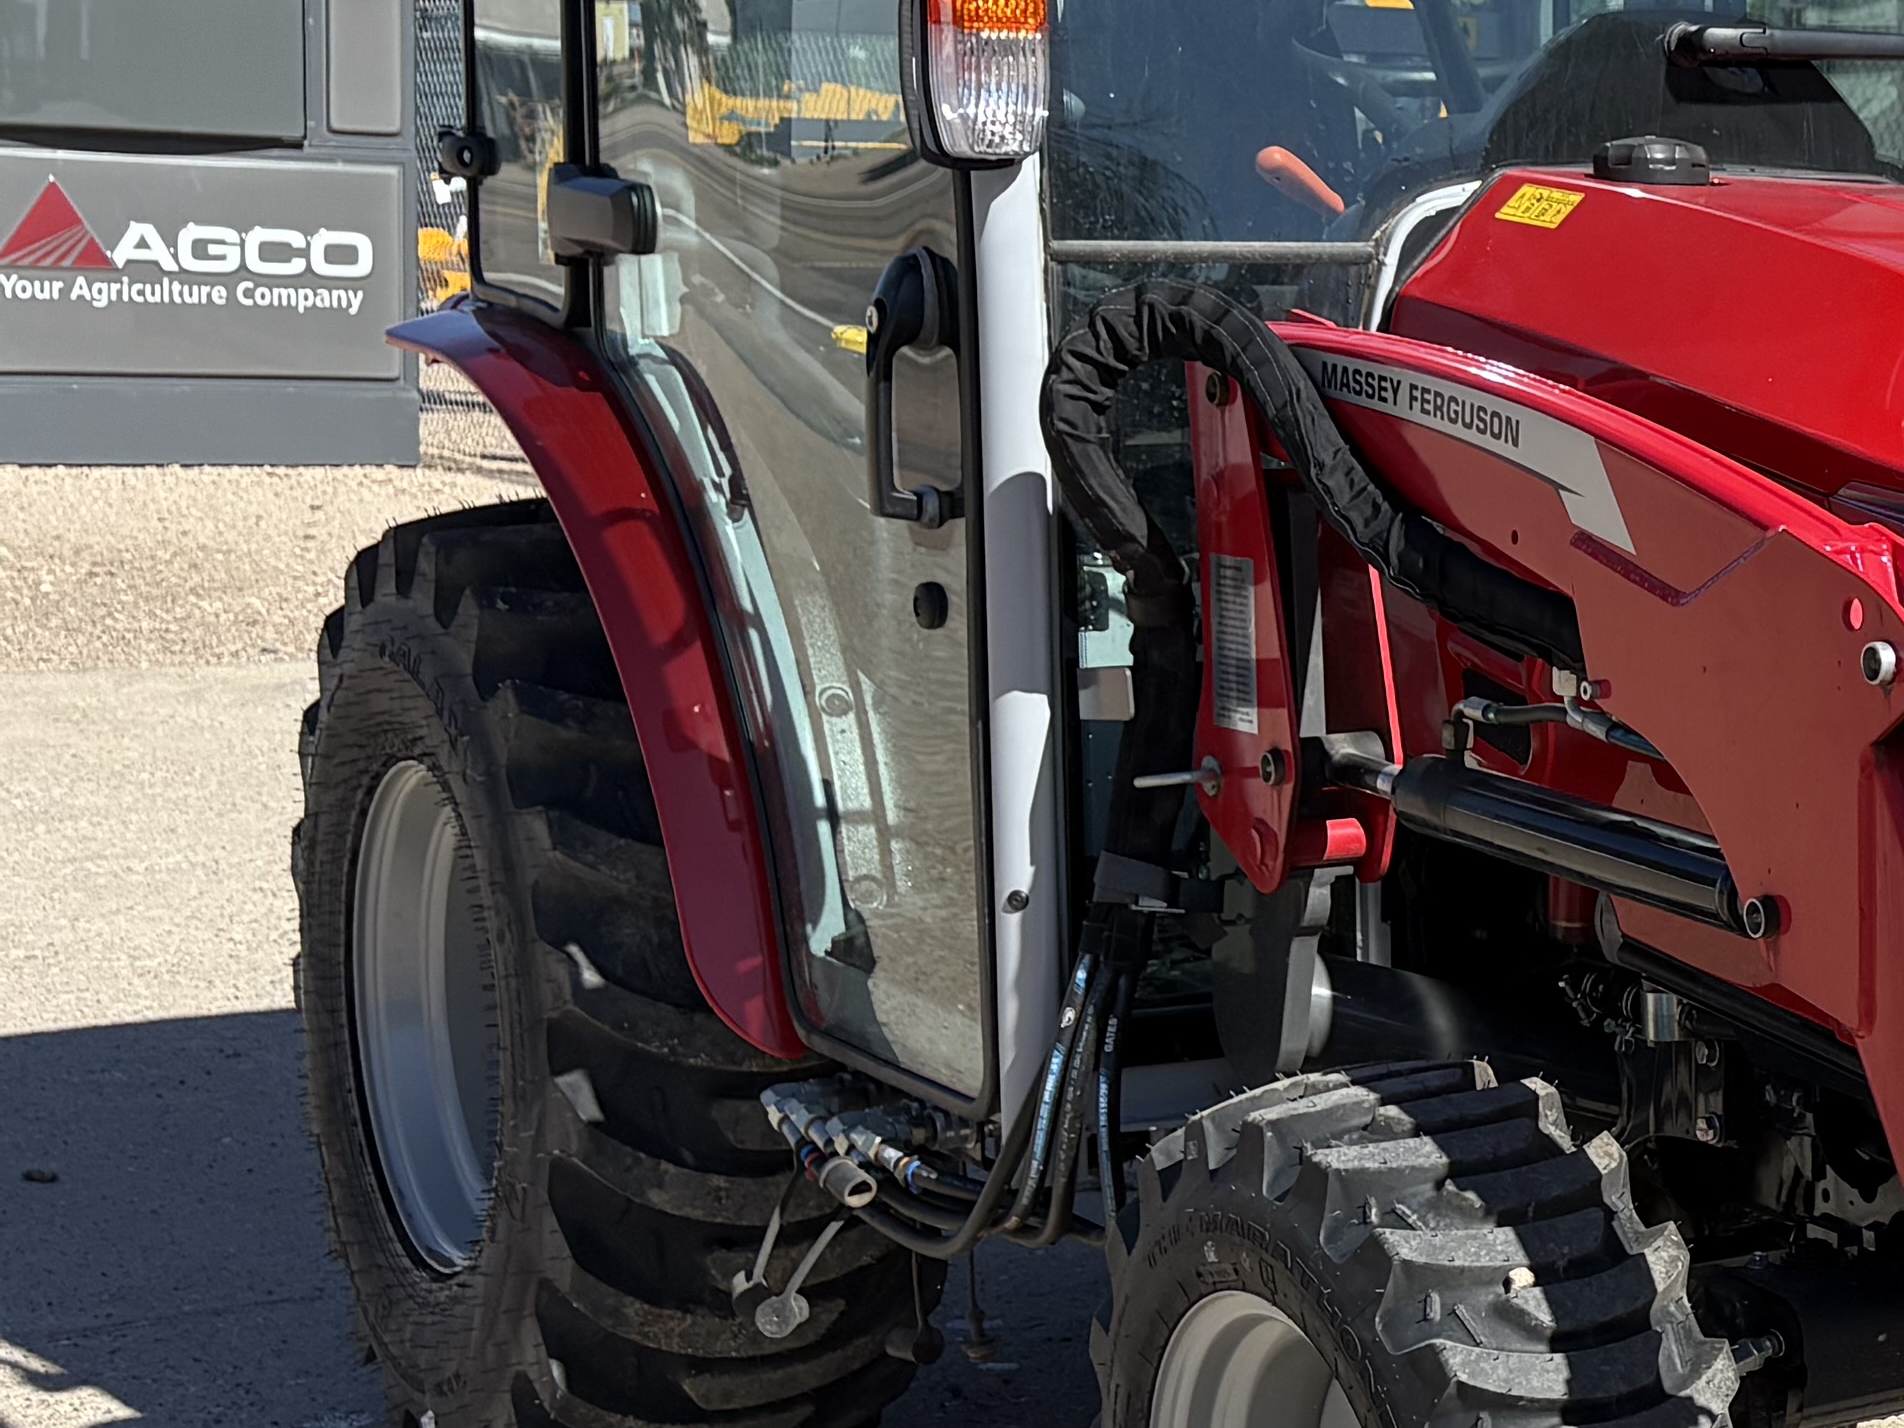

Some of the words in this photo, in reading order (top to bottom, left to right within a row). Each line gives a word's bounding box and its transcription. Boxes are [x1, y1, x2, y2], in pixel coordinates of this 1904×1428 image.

[111, 220, 374, 279] AGCO
[0, 273, 64, 301] Your
[69, 275, 227, 308] Agriculture
[236, 281, 364, 315] Company
[1321, 360, 1402, 408] MASSEY
[1408, 383, 1521, 449] FERGUSON
